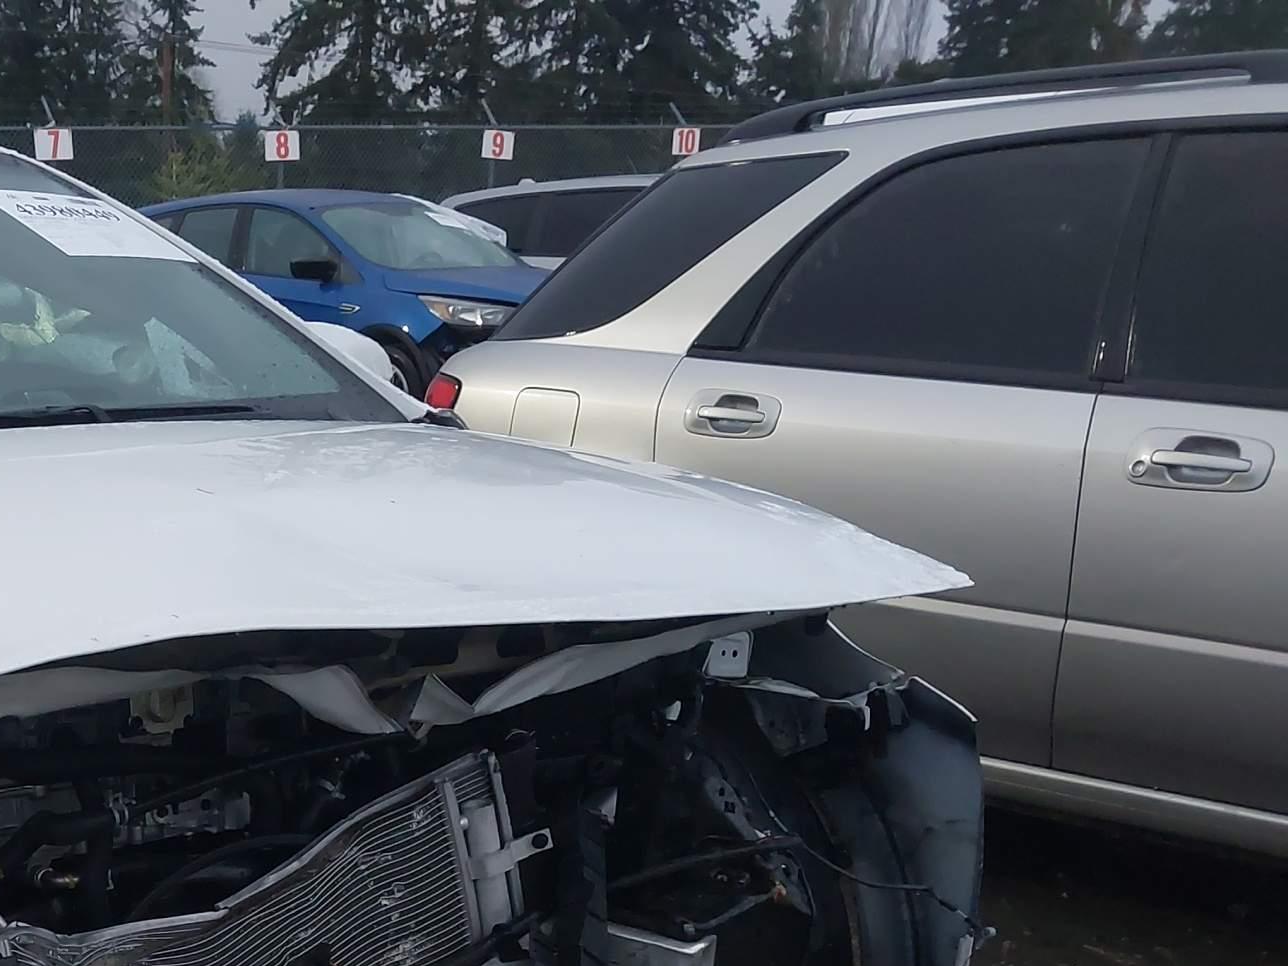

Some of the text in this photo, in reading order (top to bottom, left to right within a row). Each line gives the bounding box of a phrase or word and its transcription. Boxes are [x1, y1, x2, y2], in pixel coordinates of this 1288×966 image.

[47, 130, 60, 159] 7
[276, 132, 289, 159] 8
[492, 132, 505, 158] 9
[678, 129, 696, 153] 10
